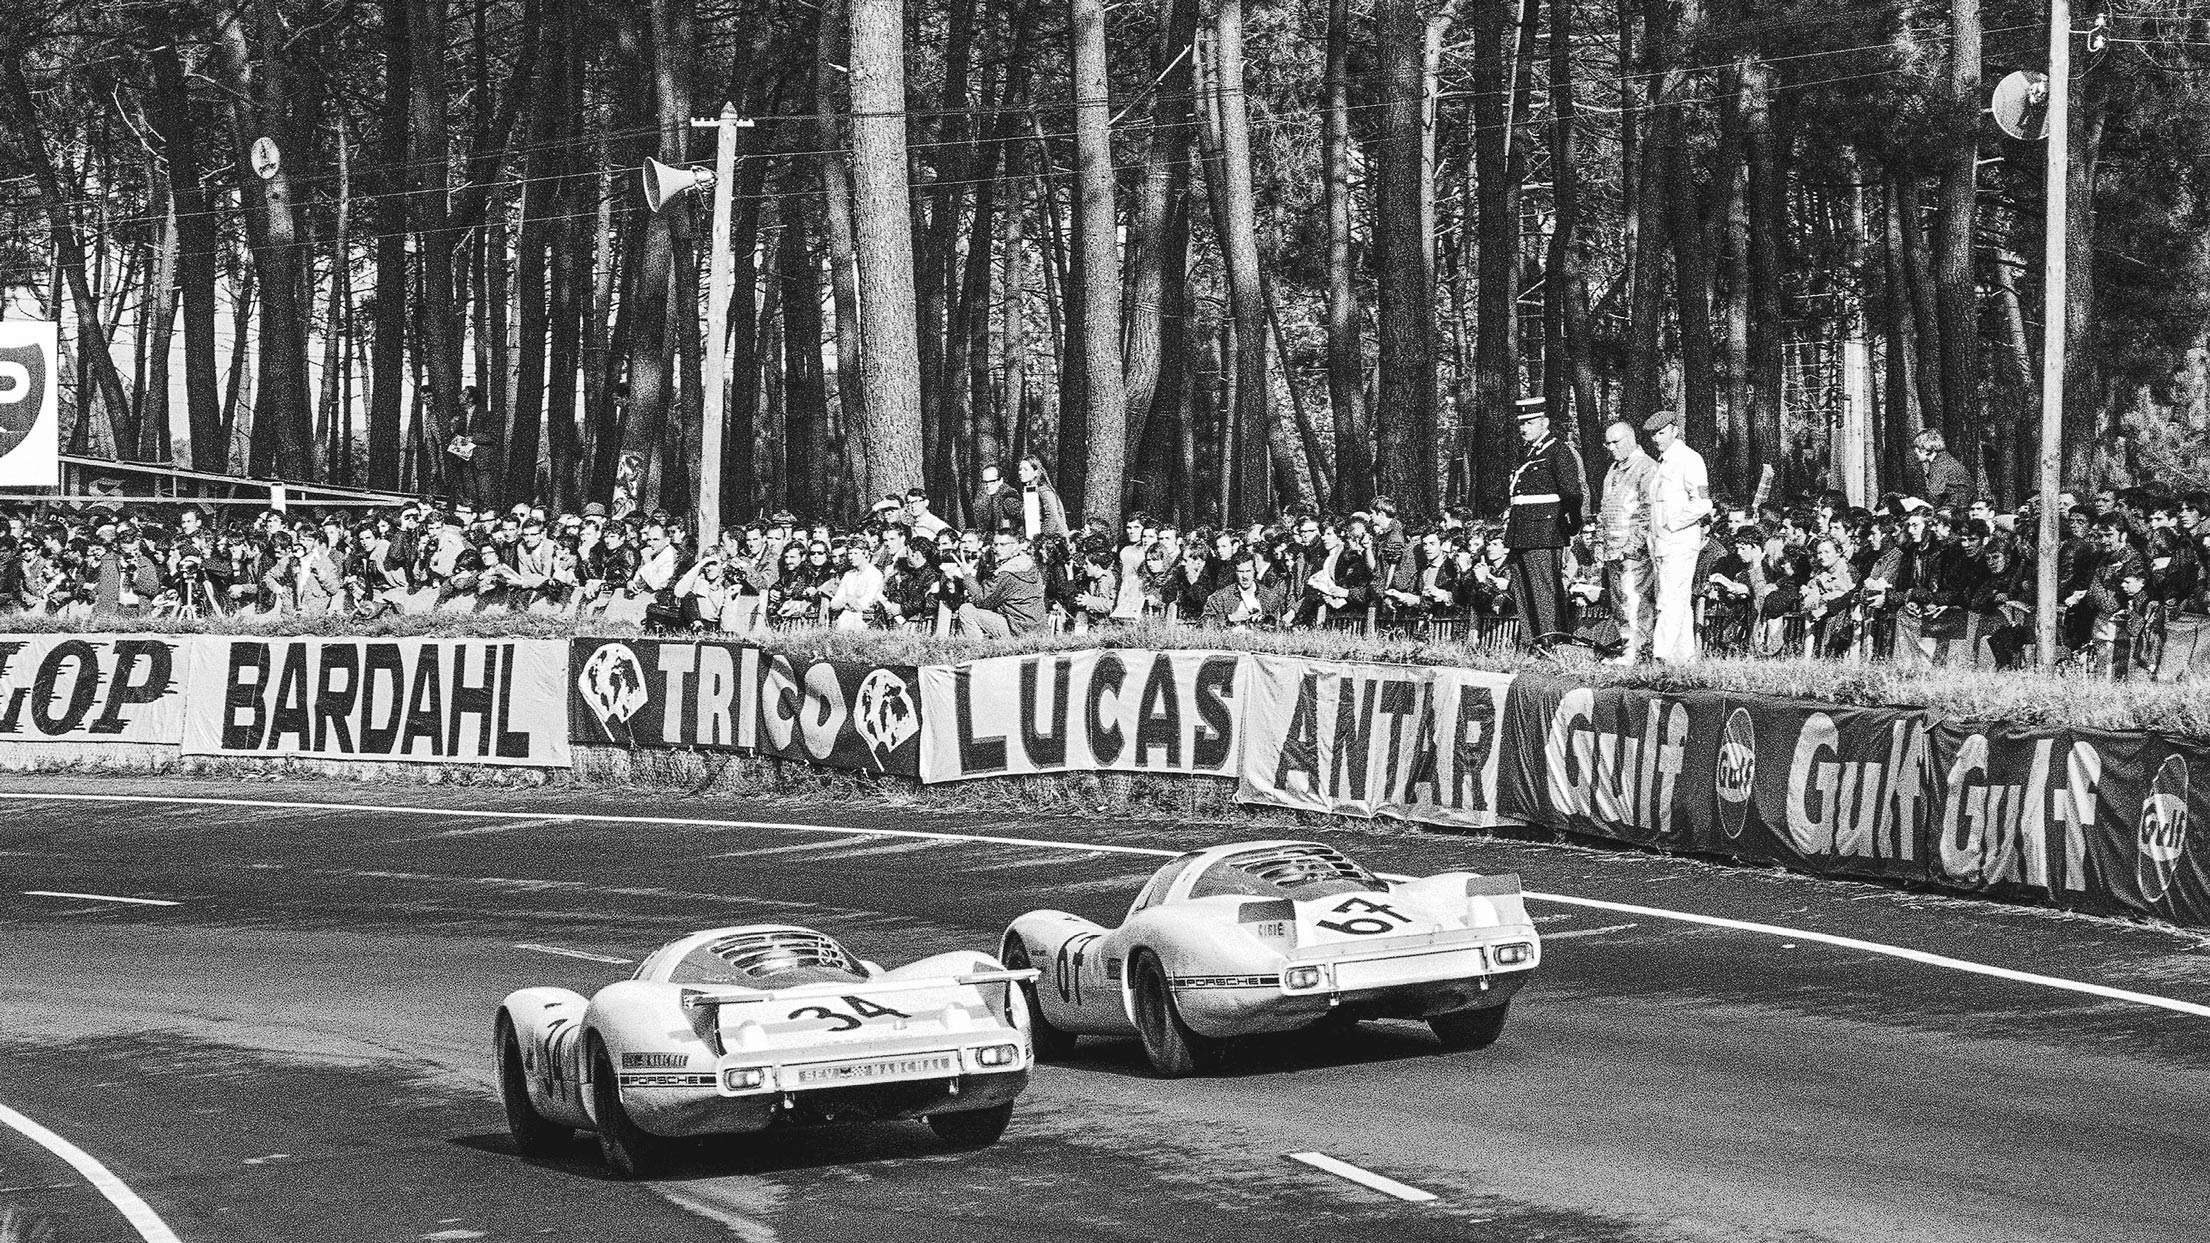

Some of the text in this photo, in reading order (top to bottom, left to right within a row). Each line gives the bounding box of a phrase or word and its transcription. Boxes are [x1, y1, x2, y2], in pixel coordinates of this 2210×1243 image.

[222, 642, 530, 758] BARDAHL
[658, 644, 847, 760] TRICO
[954, 651, 1239, 771] LUCAS
[1274, 673, 1495, 812] ANTAR
[1545, 688, 1689, 832] Gulf
[1787, 712, 1925, 861] Gulf
[1940, 734, 2101, 891] Gulf
[1316, 897, 1412, 935] 67
[787, 995, 912, 1031] 34
[1186, 976, 1259, 988] PORSCHE
[629, 1075, 698, 1086] PORSCHE
